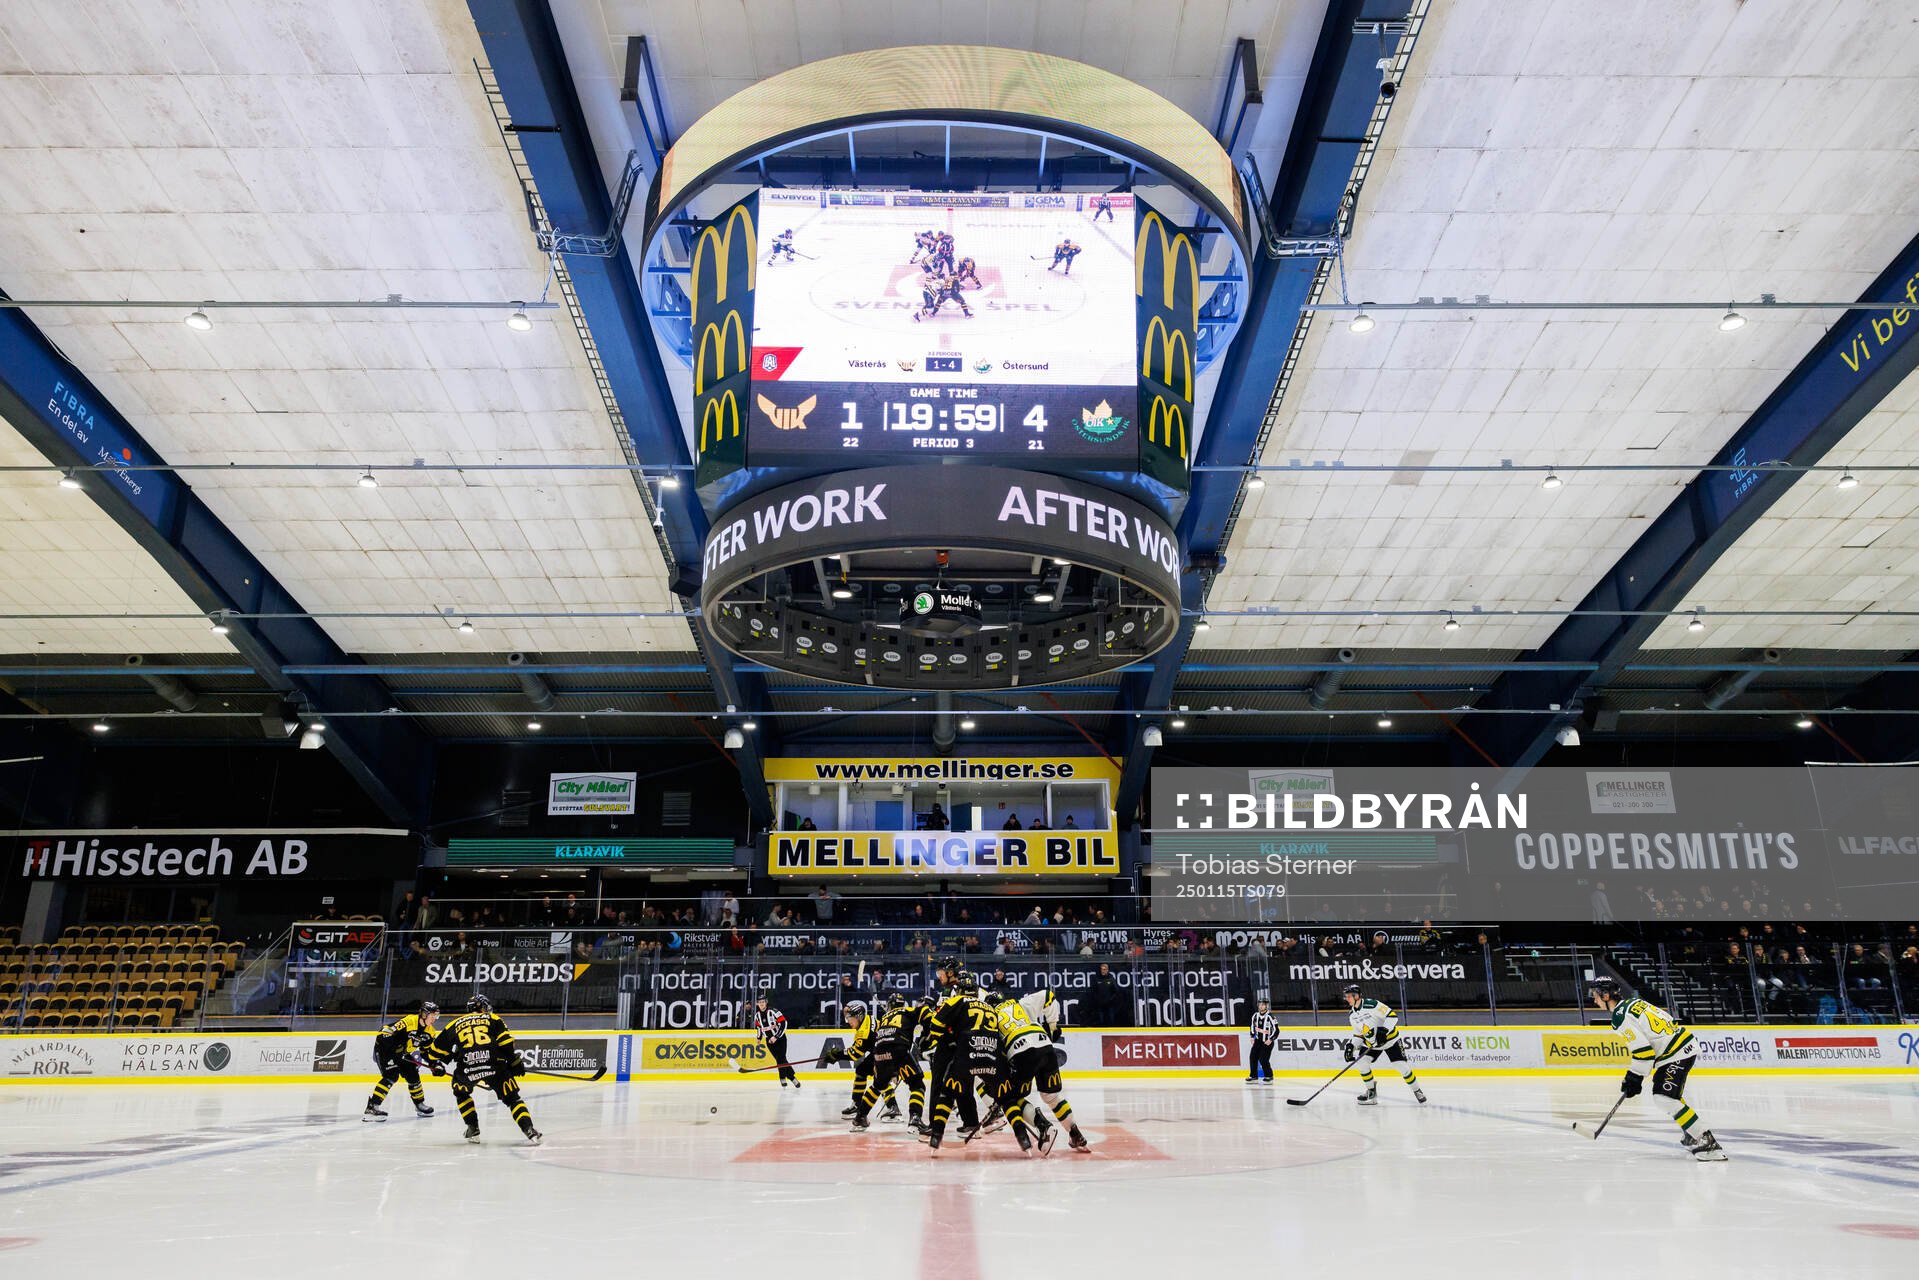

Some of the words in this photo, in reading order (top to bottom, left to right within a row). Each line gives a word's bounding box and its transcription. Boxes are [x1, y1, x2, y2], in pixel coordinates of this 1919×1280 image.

[1840, 332, 1870, 372] Vi
[1872, 272, 1919, 346] bef
[848, 360, 886, 368] Västerås
[1002, 360, 1049, 370] Östersund
[910, 388, 944, 398] GAME
[948, 388, 978, 398] TIME
[54, 382, 94, 430] FIBRA
[48, 398, 62, 418] En
[62, 414, 78, 434] del
[77, 432, 89, 444] av
[841, 402, 864, 430] 1
[892, 403, 997, 432] 19:59
[1022, 404, 1048, 432] 4
[843, 438, 859, 448] 22
[913, 438, 958, 448] PERIOD
[966, 438, 974, 448] 3
[1028, 440, 1045, 450] 21
[1734, 473, 1760, 499] FIBRA
[753, 484, 887, 544] WORK
[998, 486, 1130, 548] AFTER
[815, 759, 1074, 780] www.mellinger.se
[558, 782, 584, 795] City
[586, 780, 628, 793] Måleri
[1258, 780, 1284, 792] City
[1606, 782, 1666, 790] MELLINGER
[555, 845, 625, 858] KLARAVIK
[777, 838, 1028, 868] MELLINGER
[1046, 838, 1116, 867] BIL
[1260, 842, 1329, 854] KLARAVIK
[52, 838, 233, 876] Hisstech
[245, 838, 308, 876] AB
[996, 930, 1022, 940] Anti
[1144, 928, 1175, 938] Hyres-
[483, 940, 500, 948] Bygg
[514, 938, 536, 948] Noble
[537, 938, 548, 947] Art
[425, 963, 574, 984] SALBOHEDS
[1289, 958, 1465, 980] martin&servera
[651, 968, 714, 989] notar
[721, 968, 782, 989] notar
[1034, 968, 1096, 988] notar
[1171, 968, 1233, 988] notar
[1138, 992, 1245, 1026] notar
[968, 1008, 998, 1032] 73
[998, 1002, 1032, 1038] 24
[458, 1025, 492, 1048] 56
[1278, 1038, 1349, 1051] ELVBY
[1404, 1036, 1446, 1050] SKYLT
[1451, 1037, 1462, 1050] &
[1466, 1036, 1510, 1050] NEON
[1697, 1036, 1760, 1053] ovaReko
[12, 1042, 94, 1066] MÄLARDALENS
[124, 1044, 198, 1056] KOPPAR
[260, 1050, 292, 1062] Noble
[294, 1050, 312, 1062] Art
[542, 1048, 584, 1058] BEMANNING
[655, 1040, 766, 1060] axelssons
[1114, 1042, 1228, 1058] MERITMIND
[1434, 1054, 1464, 1062] bildekor
[1550, 1041, 1630, 1058] Assemblin
[1869, 1048, 1881, 1059] AB
[32, 1058, 70, 1075] RÖR
[122, 1058, 198, 1072] HÄLSAN
[550, 1058, 597, 1068] REKRYTERING
